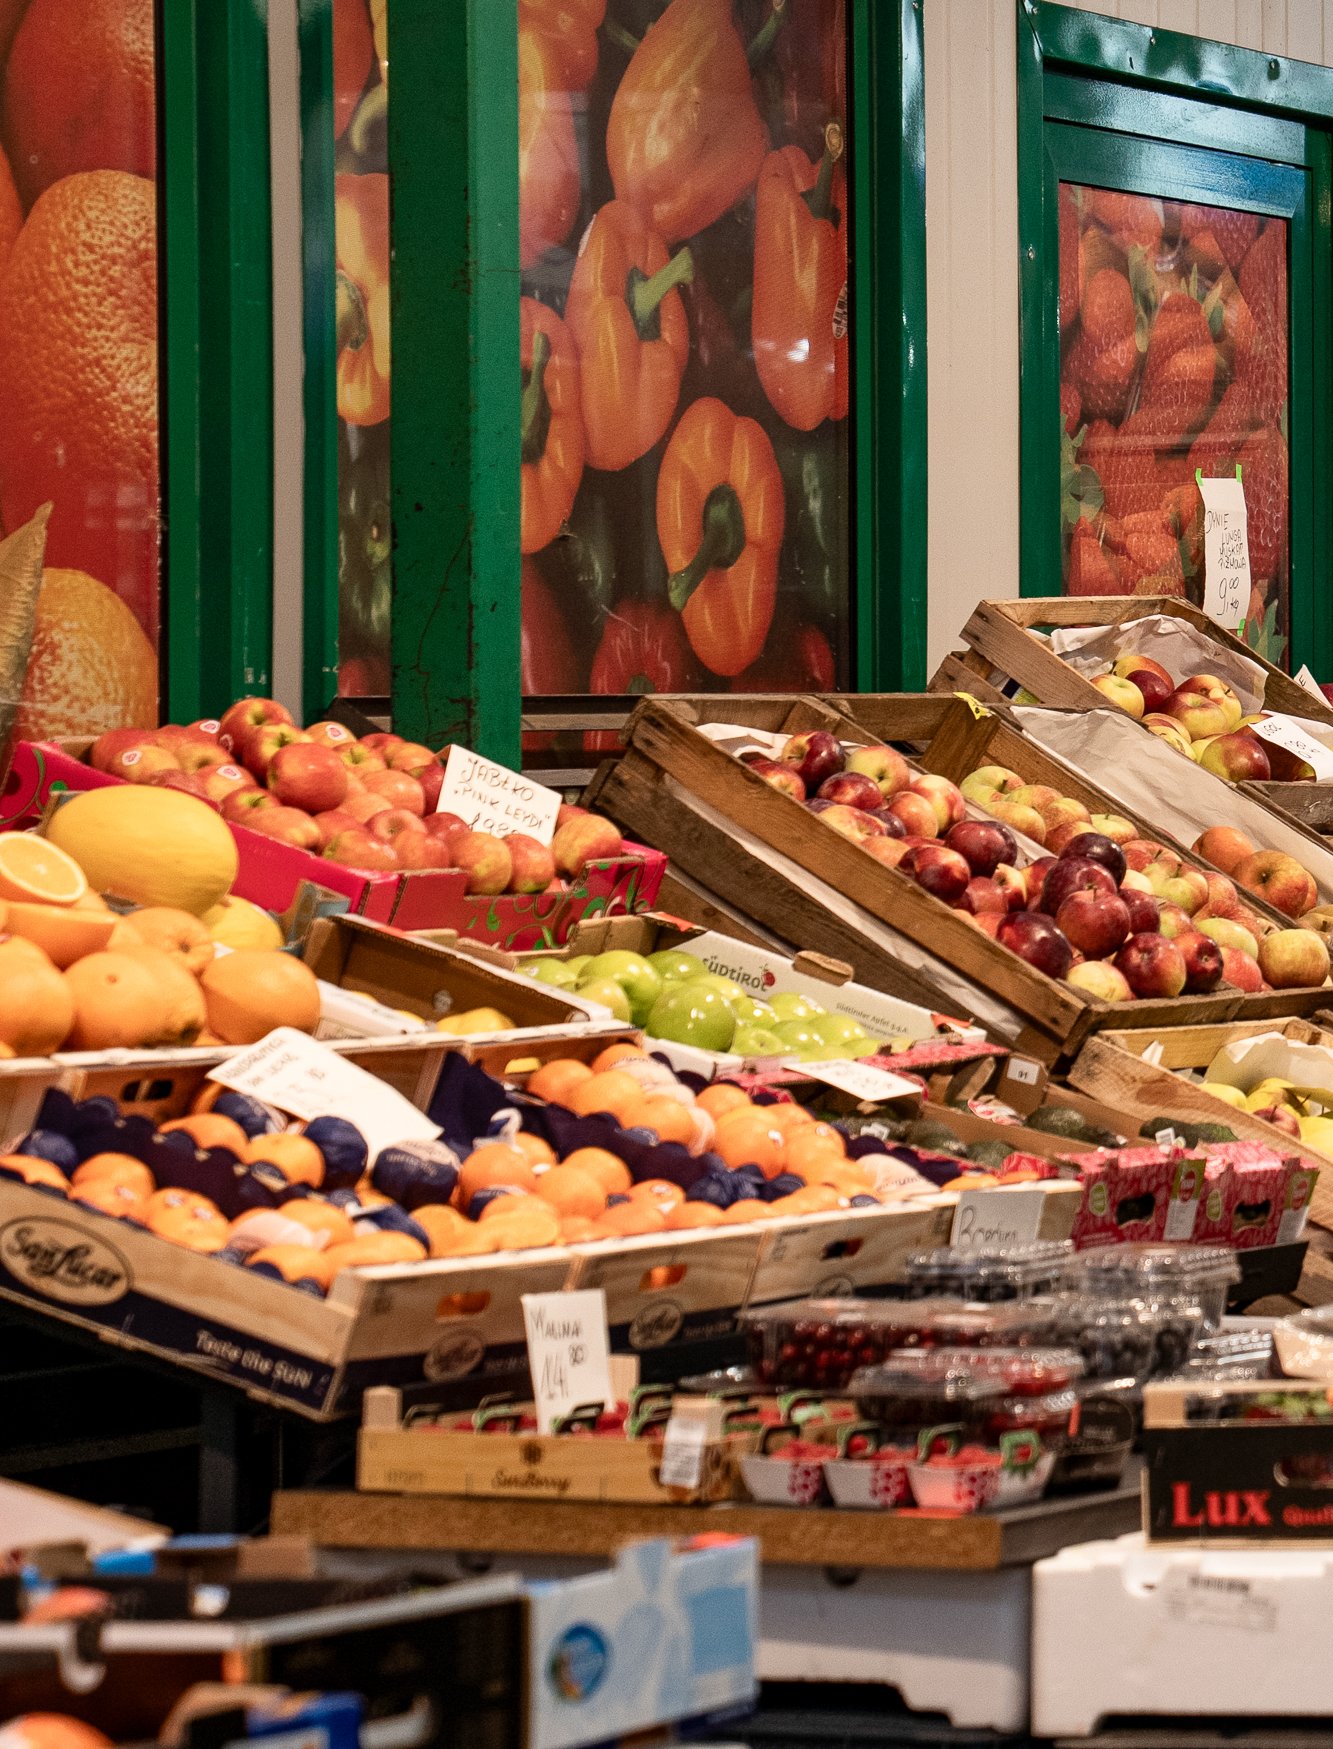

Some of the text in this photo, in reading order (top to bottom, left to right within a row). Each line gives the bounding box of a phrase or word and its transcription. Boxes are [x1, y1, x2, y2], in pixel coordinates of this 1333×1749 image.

[1206, 510, 1230, 534] DYNIE
[458, 758, 534, 801] JABŁKO
[196, 1328, 243, 1363] Taste
[240, 1347, 274, 1375] the
[1171, 1480, 1273, 1527] Lux
